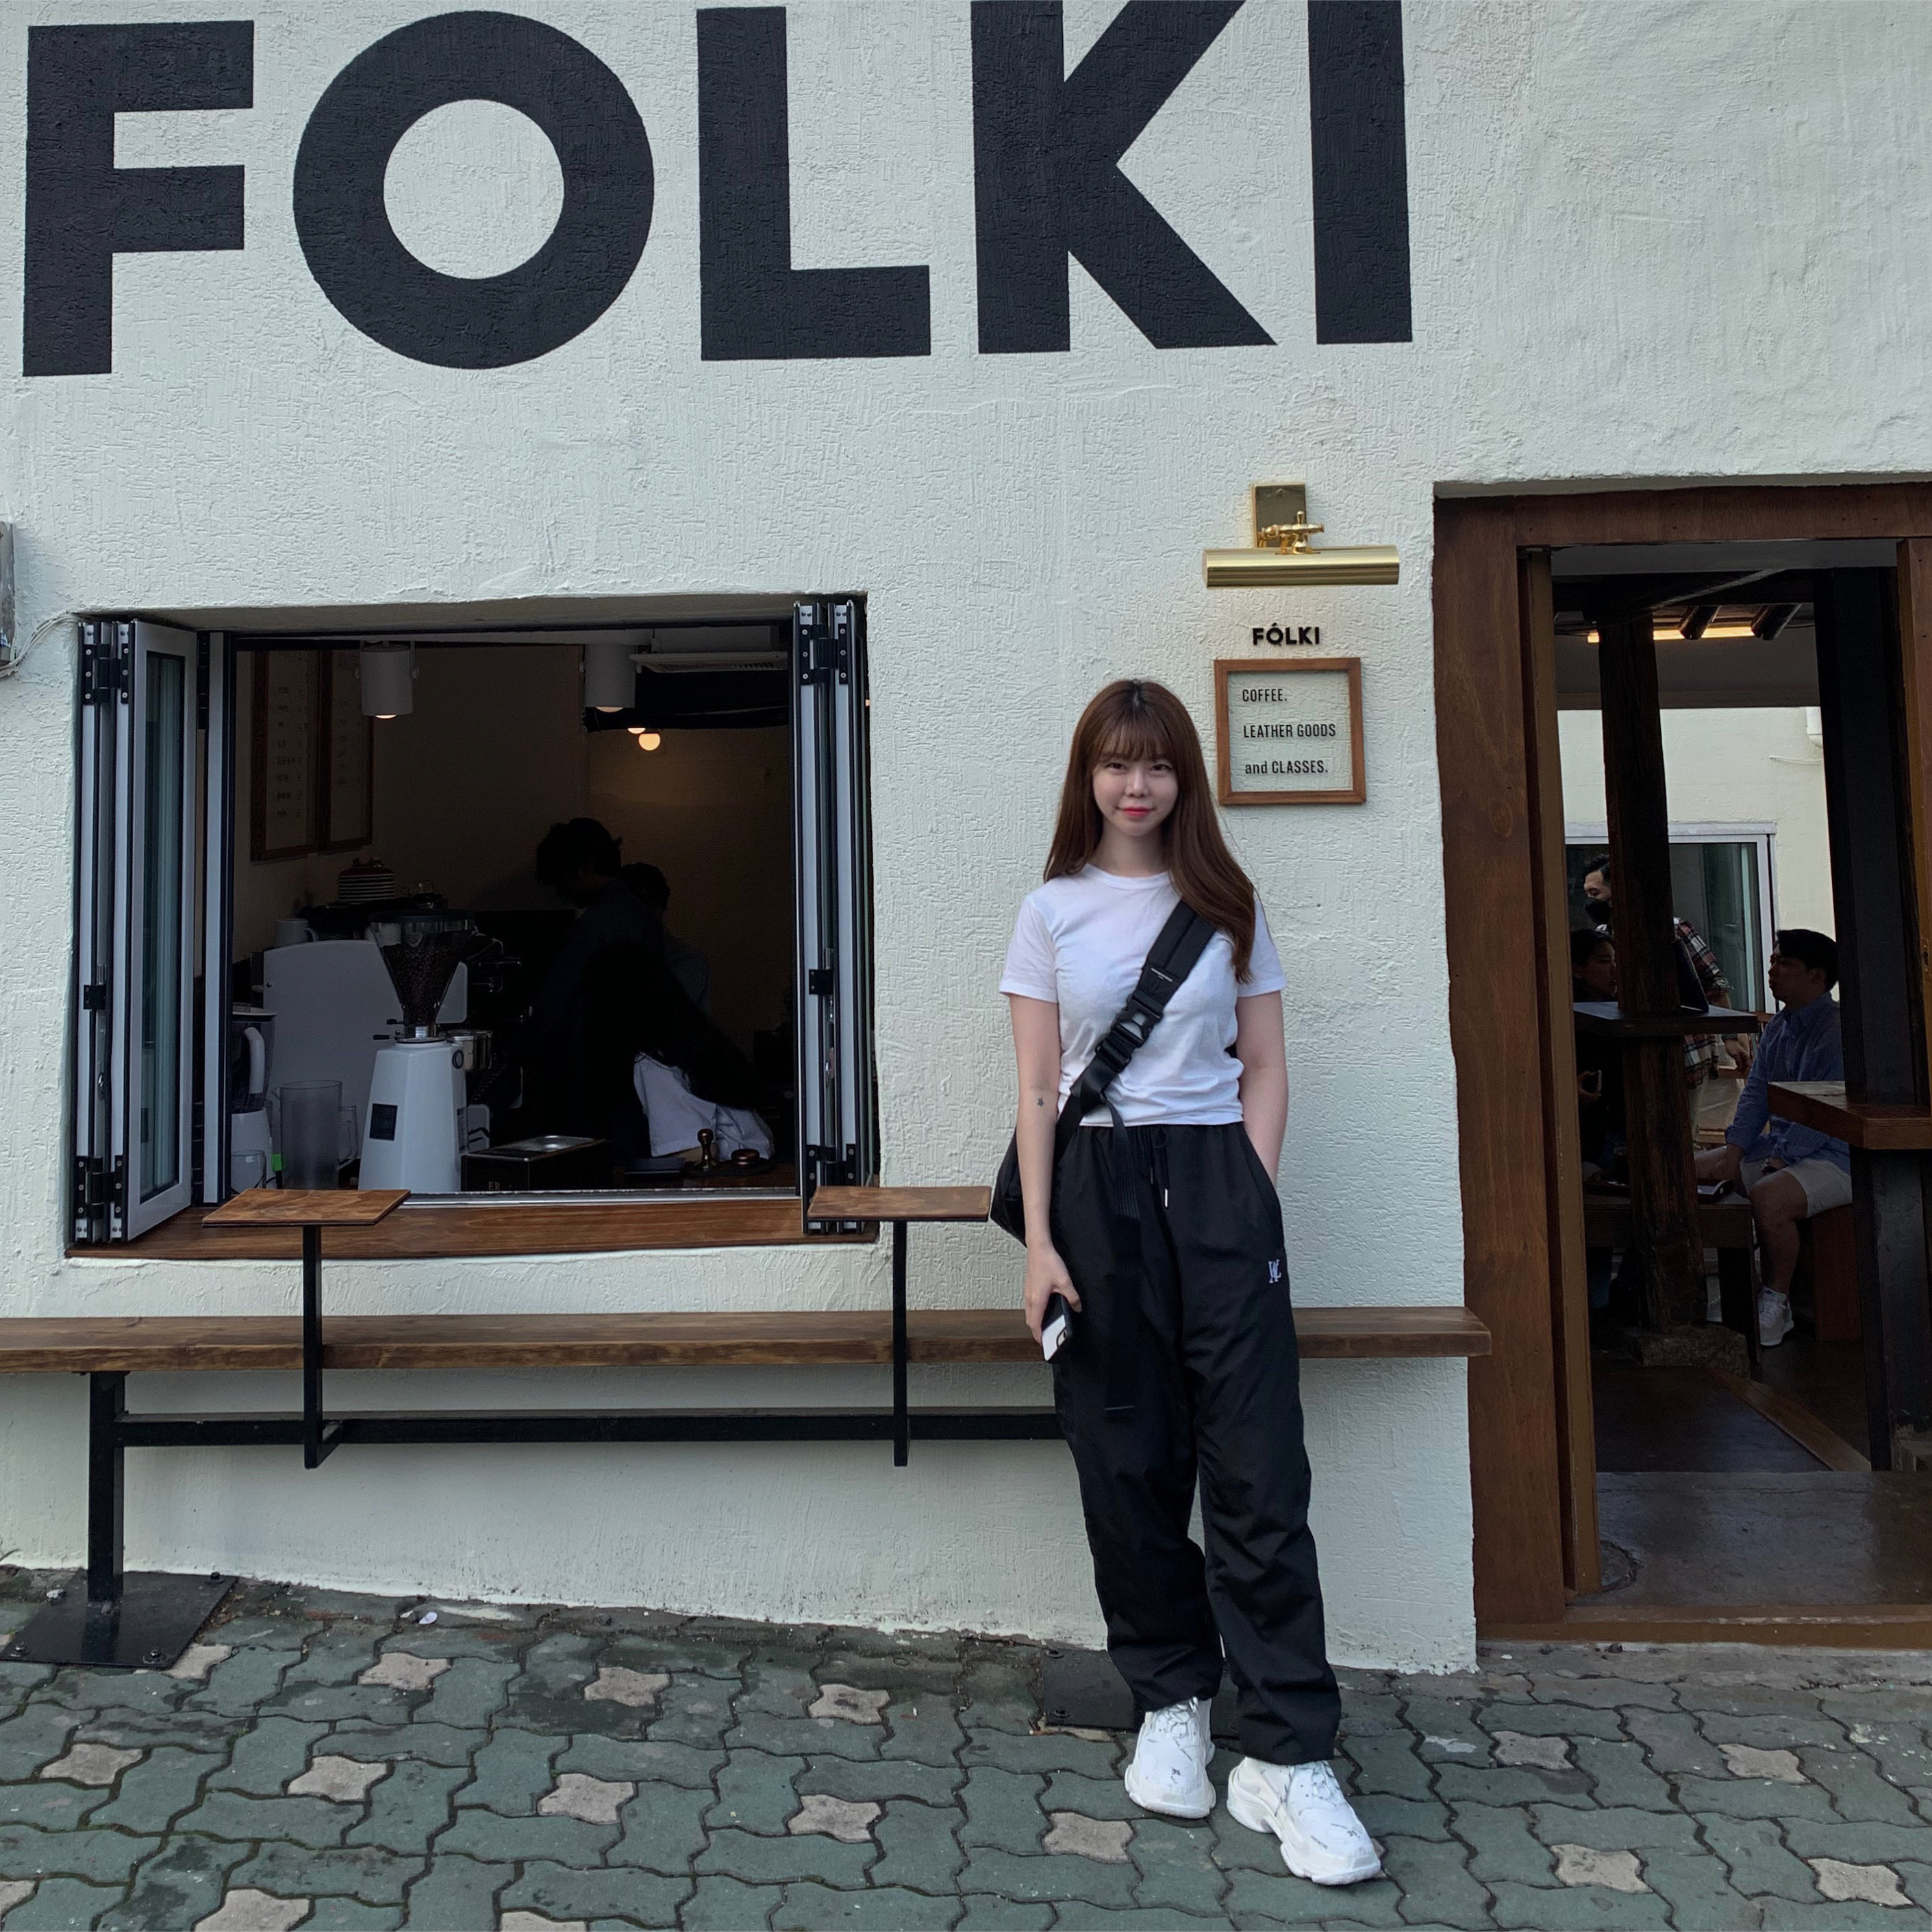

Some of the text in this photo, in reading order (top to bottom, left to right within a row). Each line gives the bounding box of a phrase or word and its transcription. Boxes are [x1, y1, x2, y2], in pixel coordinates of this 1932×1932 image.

[1252, 623, 1320, 647] FÓLKI
[1242, 688, 1288, 702] COFFEE.
[1243, 723, 1336, 738] LEATHER GOODS
[1244, 760, 1329, 775] and CLASSES.
